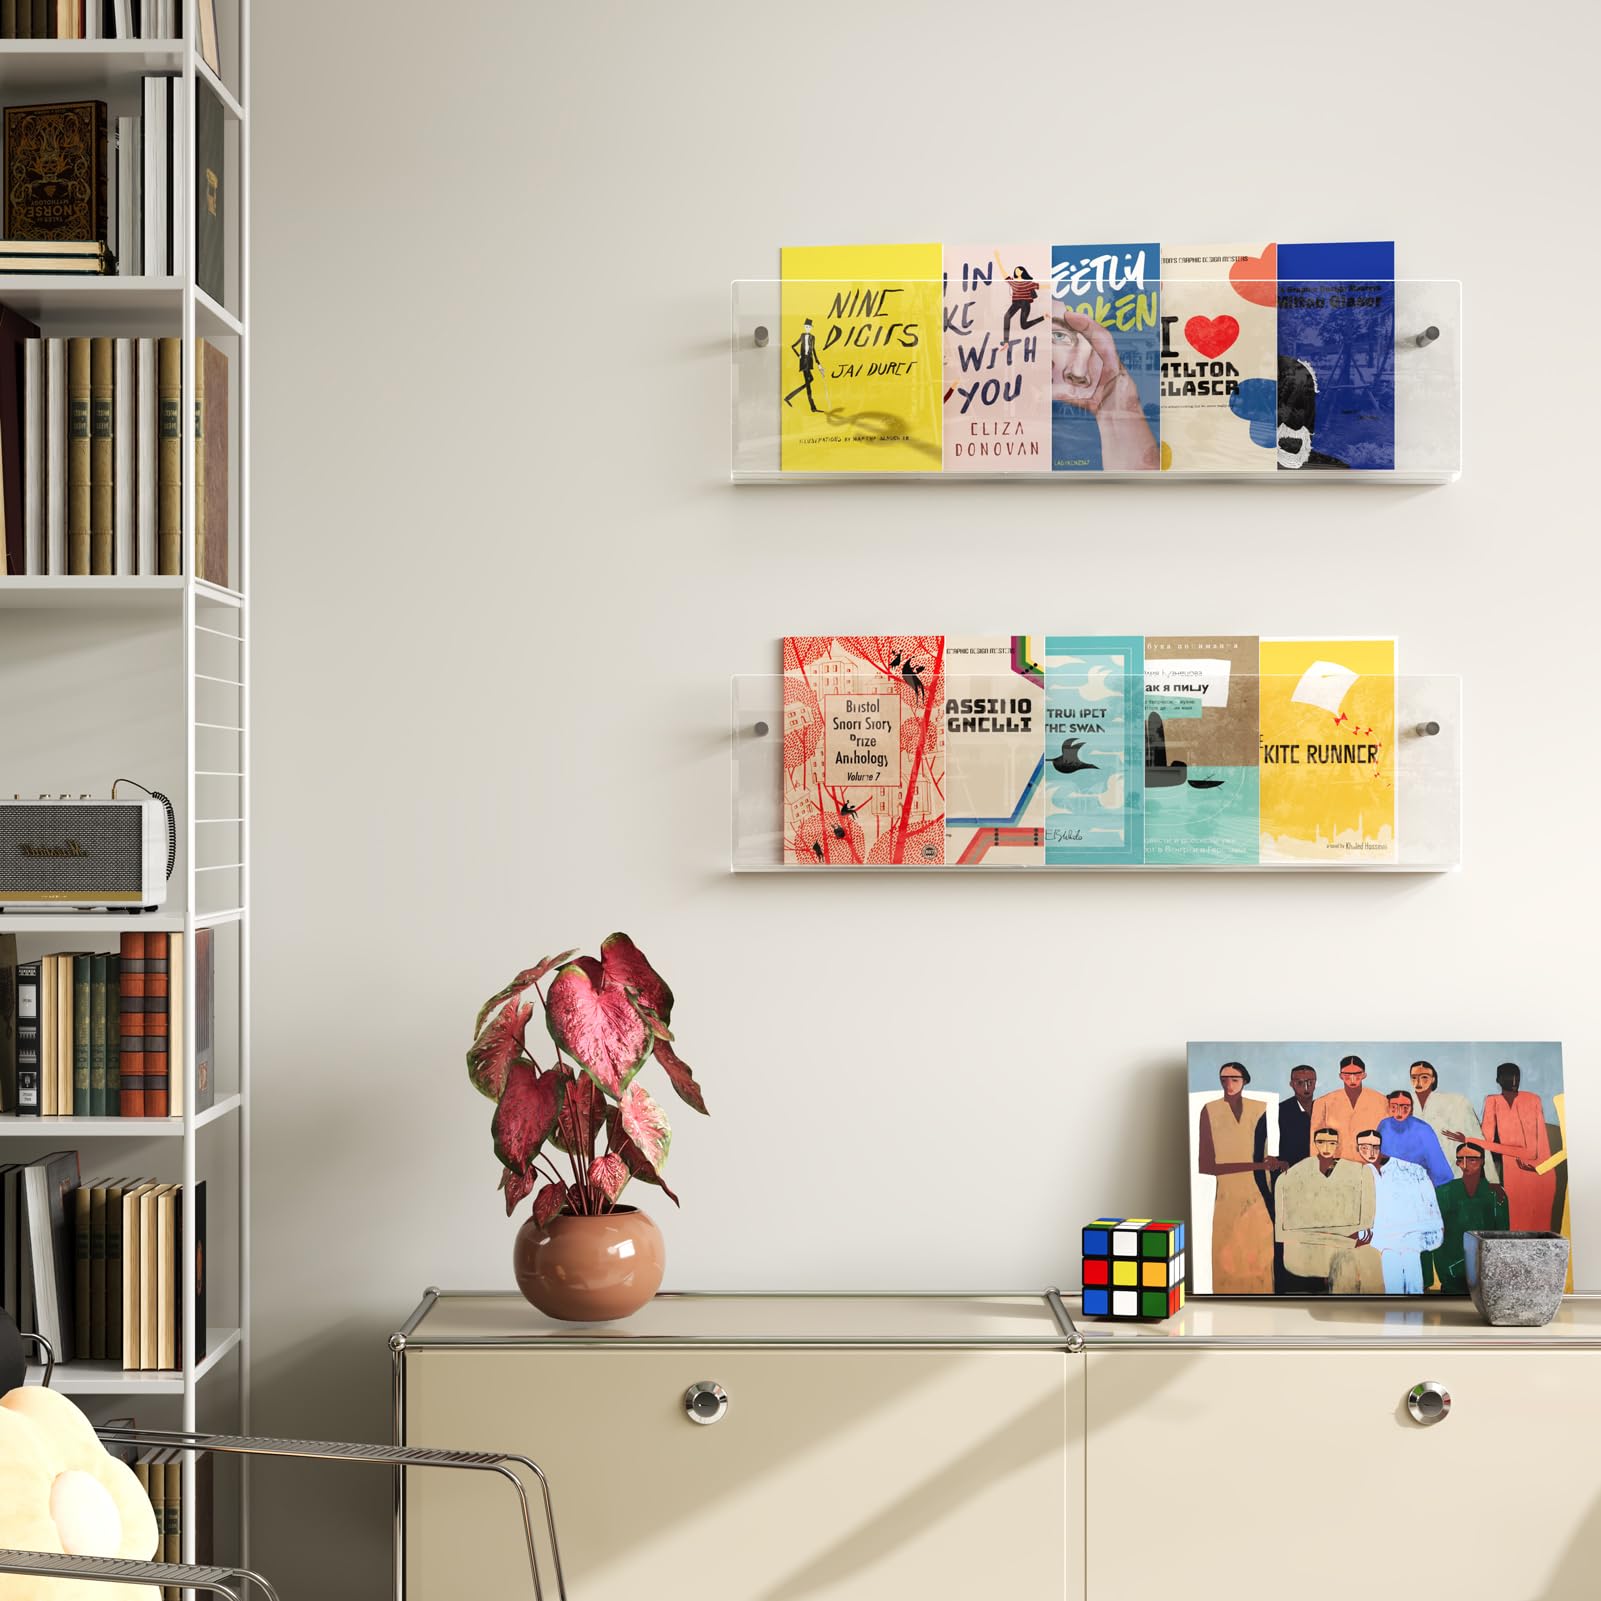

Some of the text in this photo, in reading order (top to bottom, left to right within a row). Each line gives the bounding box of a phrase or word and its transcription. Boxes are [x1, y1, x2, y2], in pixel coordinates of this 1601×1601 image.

[27, 205, 73, 217] NORSE
[962, 261, 994, 293] IN
[827, 288, 904, 319] NINE
[822, 323, 919, 351] DIGITS
[1161, 316, 1179, 358] I
[957, 331, 1038, 373] WITH
[831, 364, 864, 379] JAI
[957, 373, 1023, 415] YOU
[970, 421, 1024, 436] ELIZA
[954, 441, 1039, 457] DONOVAN
[1145, 684, 1160, 692] ак
[1173, 684, 1209, 694] пишу
[846, 698, 880, 713] Bristol
[1046, 708, 1107, 719] TRUMPET
[833, 716, 892, 733] Short Story
[1069, 723, 1106, 733] SWAN
[849, 733, 877, 747] Prize
[835, 749, 889, 767] Anthology
[1264, 744, 1378, 764] KITE RUNNER
[847, 771, 881, 781] Volume 7
